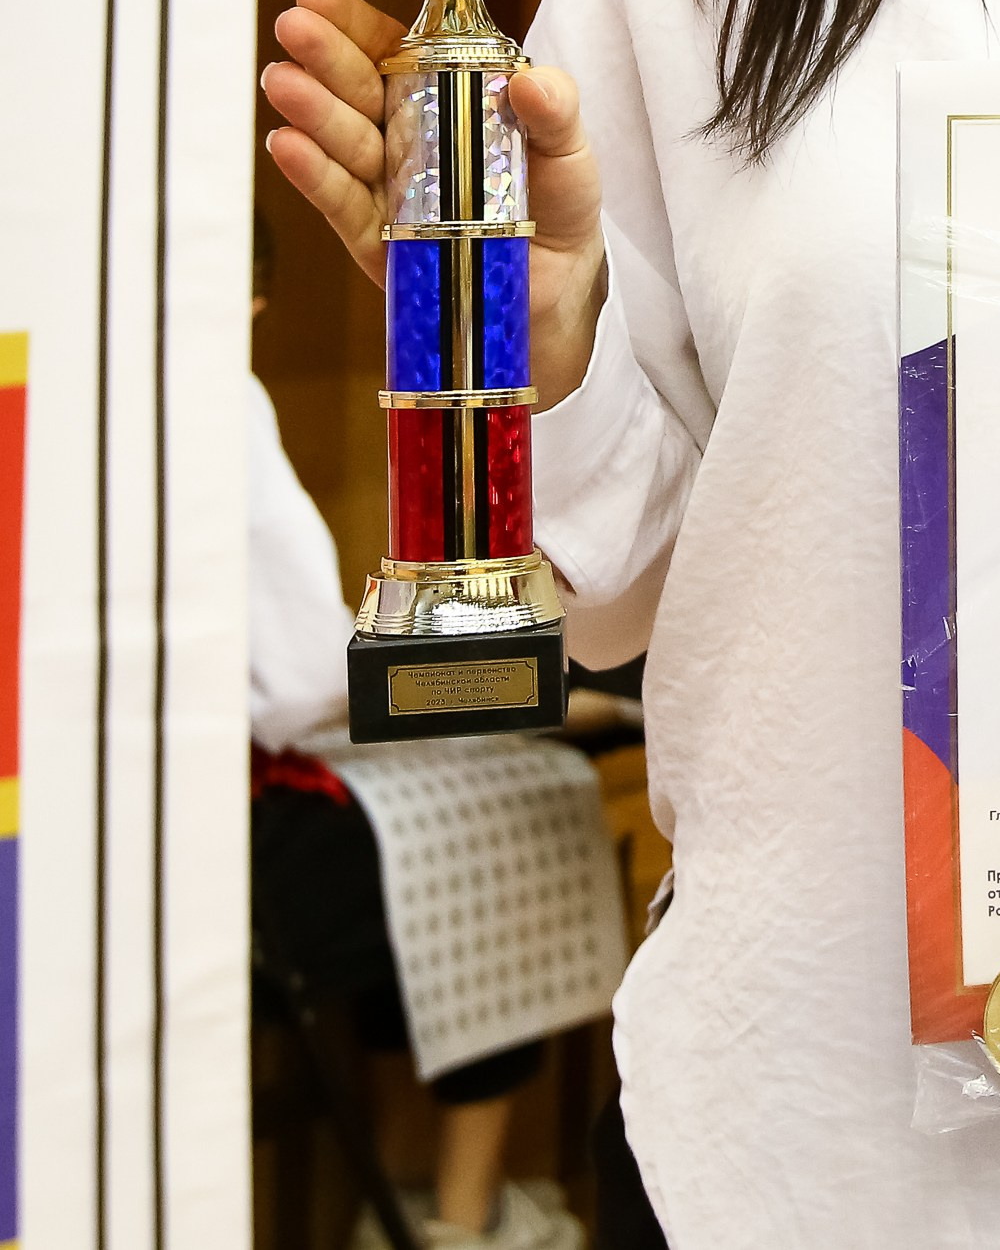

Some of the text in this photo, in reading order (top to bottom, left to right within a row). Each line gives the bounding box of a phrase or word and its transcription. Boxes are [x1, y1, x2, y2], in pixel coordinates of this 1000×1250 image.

[408, 670, 455, 678] Чемпионат
[466, 667, 516, 676] первенство
[474, 676, 510, 684] области
[444, 687, 462, 695] ЧИР
[464, 686, 495, 694] спорту
[426, 698, 446, 706] 2023
